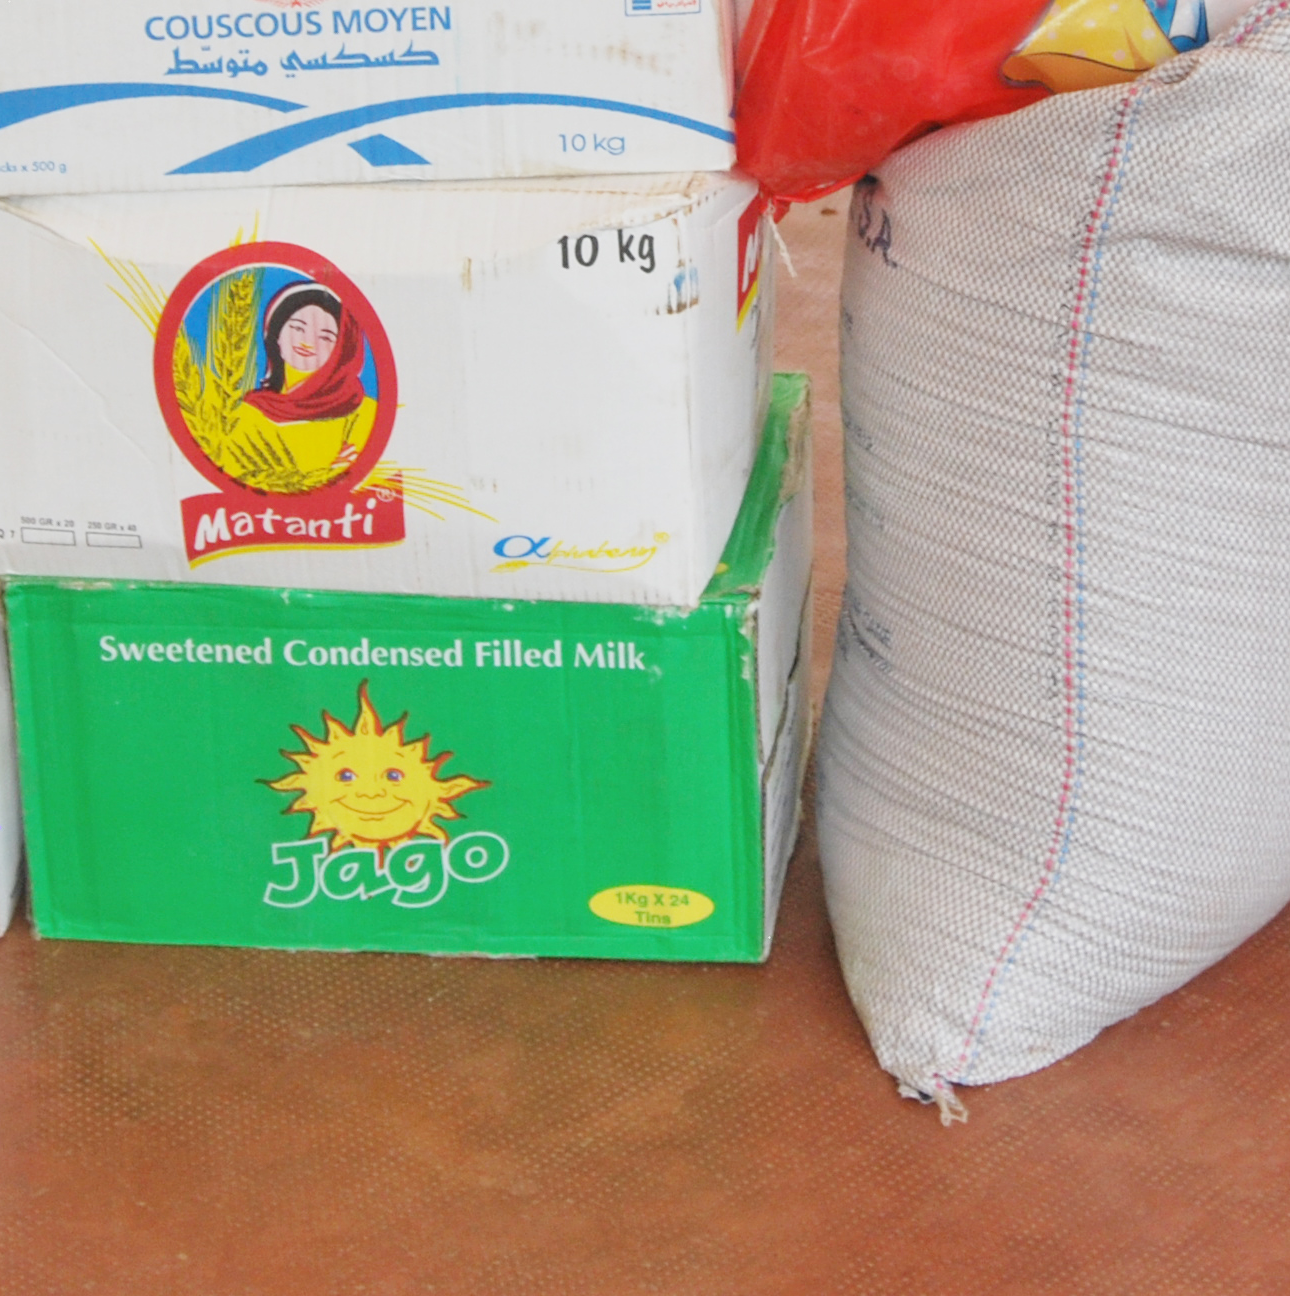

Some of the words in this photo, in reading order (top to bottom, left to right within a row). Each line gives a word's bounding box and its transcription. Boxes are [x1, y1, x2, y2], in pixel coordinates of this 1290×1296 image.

[145, 10, 322, 41] COUSCOUS
[332, 6, 452, 34] MOYEN
[559, 133, 586, 153] 10
[592, 132, 625, 155] kg
[31, 160, 56, 173] 500
[557, 234, 599, 269] 10
[617, 229, 656, 273] kg
[193, 498, 377, 551] Matanti
[99, 636, 272, 666] Sweetened
[283, 639, 464, 669] Condensed
[474, 639, 564, 670] Filled
[573, 641, 647, 672] Milk
[263, 831, 510, 909] Jago
[614, 891, 647, 910] 1Kg
[653, 893, 666, 907] X
[670, 893, 690, 908] 24
[634, 910, 672, 926] Tins
